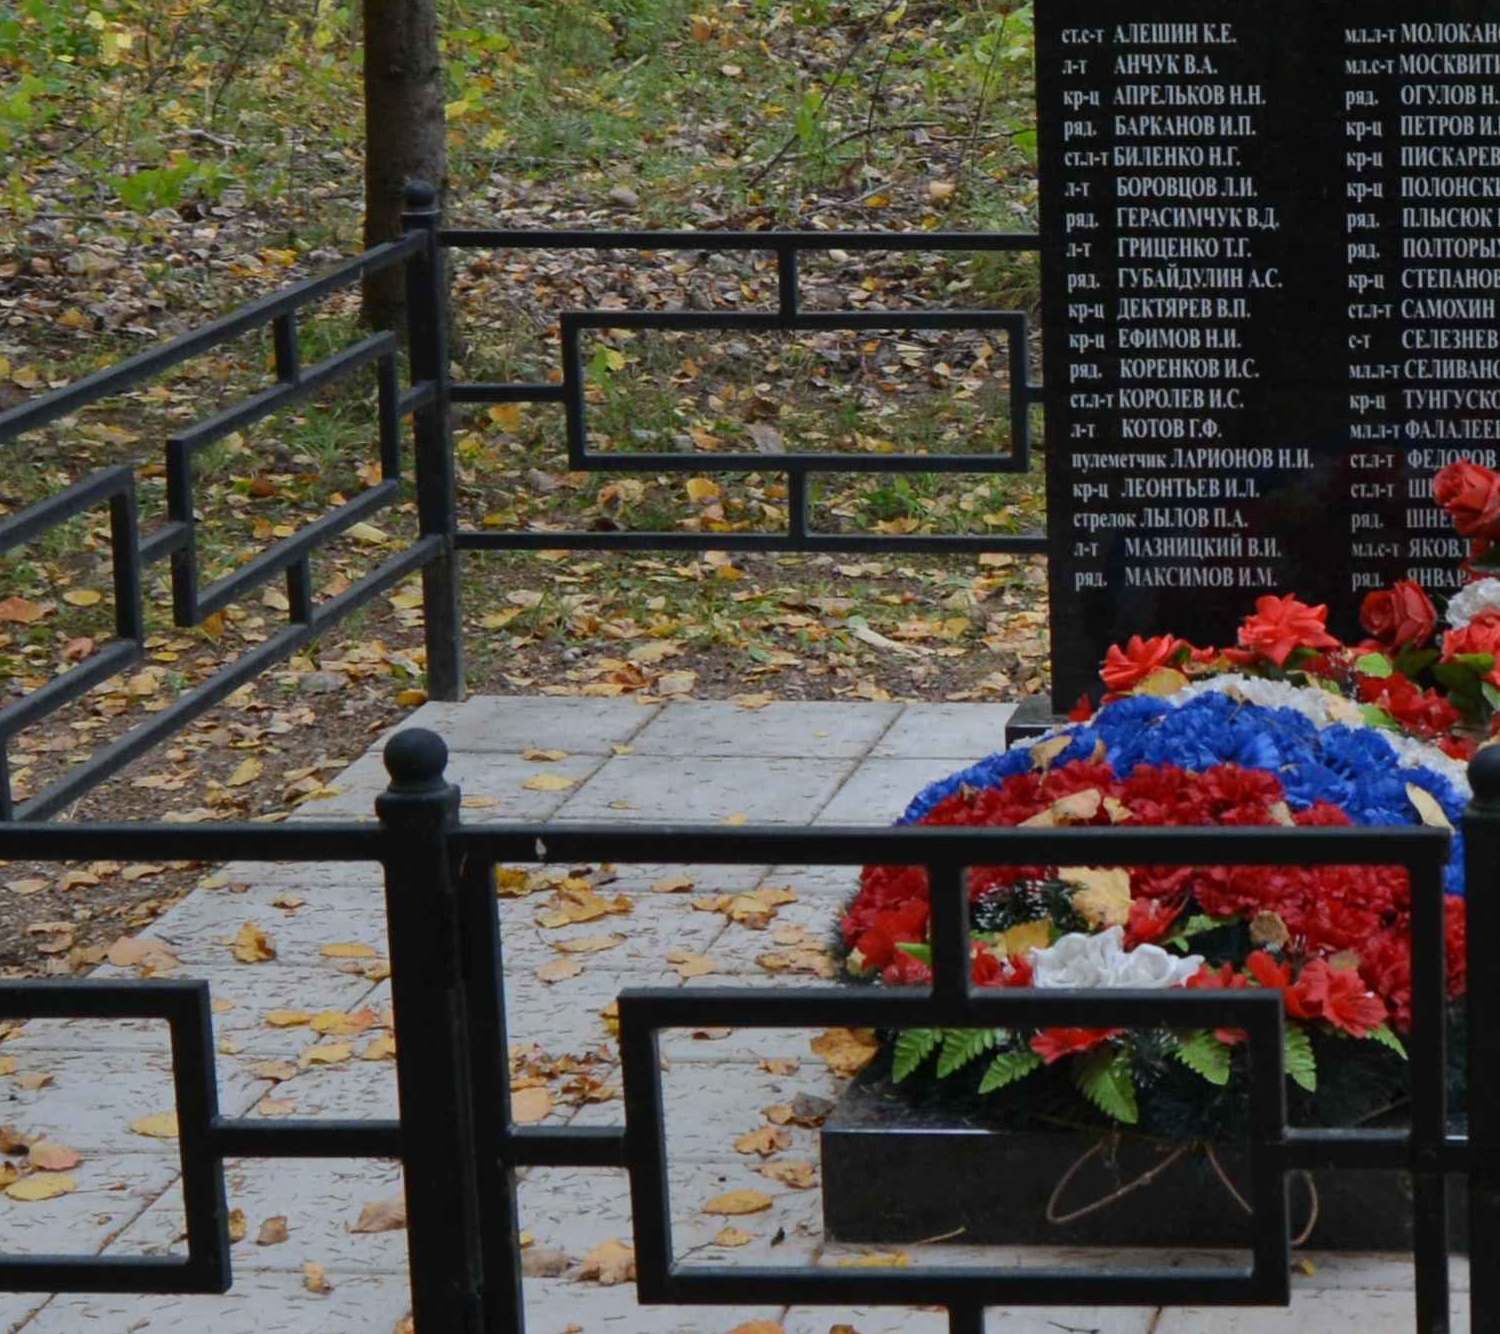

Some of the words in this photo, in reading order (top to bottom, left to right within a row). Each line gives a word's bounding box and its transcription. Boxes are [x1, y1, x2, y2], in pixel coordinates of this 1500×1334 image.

[1062, 28, 1104, 43] ст.с-т
[1114, 24, 1197, 43] АЛЕШИН
[1204, 24, 1236, 43] К.Е.
[1345, 28, 1396, 43] мл.л-т
[1062, 59, 1087, 74] л-т
[1115, 54, 1179, 74] АНЧУК
[1185, 54, 1217, 74] В.А.
[1346, 59, 1394, 74] мл.с-т
[1064, 90, 1100, 111] кр-ц
[1114, 85, 1225, 105] АПРЕЛЬКОВ
[1230, 85, 1266, 104] Н.Н.
[1346, 90, 1378, 110] ряд.
[1401, 85, 1476, 105] ОГУЛОВ
[1064, 120, 1097, 141] ряд.
[1116, 116, 1215, 135] БАРКАНОВ
[1220, 116, 1256, 135] И.П.
[1347, 121, 1382, 141] кр-ц
[1401, 116, 1474, 136] ПЕТРОВ
[1065, 151, 1108, 166] ст.л-т
[1114, 147, 1204, 166] БИЛЕНКО
[1209, 147, 1240, 166] Н.Г.
[1347, 151, 1382, 171] кр-ц
[1402, 147, 1500, 166] ПИСКАРЕВ
[1065, 181, 1090, 196] л-т
[1117, 177, 1217, 199] БОРОВЦОВ
[1221, 177, 1257, 197] Л.И.
[1347, 182, 1383, 203] кр-ц
[1066, 212, 1099, 232] ряд.
[1117, 207, 1242, 227] ГЕРАСИМЧУК
[1247, 208, 1279, 229] В.Д.
[1347, 213, 1380, 233] ряд.
[1403, 208, 1493, 227] ПЛЫСЮК
[1066, 242, 1091, 257] л-т
[1118, 238, 1219, 259] ГРИЦЕНКО
[1223, 238, 1251, 257] Т.Г.
[1348, 242, 1380, 264] ряд.
[1068, 273, 1100, 293] ряд.
[1118, 263, 1243, 290] ГУБАЙДУЛИН
[1249, 268, 1282, 288] А.С.
[1348, 274, 1384, 294] кр-ц
[1069, 303, 1104, 323] кр-ц
[1117, 298, 1212, 320] ДЕКТЯРЕВ
[1217, 298, 1250, 318] В.П.
[1348, 303, 1392, 318] ст.л-т
[1401, 299, 1495, 318] САМОХИН
[1070, 333, 1105, 353] кр-ц
[1119, 328, 1200, 348] ЕФИМОВ
[1206, 329, 1241, 348] Н.И.
[1349, 334, 1370, 349] с-т
[1402, 329, 1498, 349] СЕЛЕЗНЕВ
[1070, 363, 1102, 383] ряд.
[1121, 359, 1219, 378] КОРЕНКОВ
[1225, 358, 1259, 378] И.С.
[1349, 364, 1399, 379] мл.л-т
[1070, 393, 1114, 408] ст.л-т
[1120, 389, 1204, 408] КОРОЛЕВ
[1210, 389, 1244, 408] И.С.
[1350, 394, 1385, 414] кр-ц
[1071, 423, 1095, 438] л-т
[1122, 419, 1184, 438] КОТОВ
[1189, 419, 1222, 438] Г.Ф.
[1350, 424, 1400, 439] мл.л-т
[1072, 453, 1166, 473] пулеметчик
[1171, 449, 1273, 468] ЛАРИОНОВ
[1279, 449, 1314, 468] Н.И.
[1350, 453, 1394, 468] ст.л-т
[1073, 483, 1108, 502] кр-ц
[1121, 478, 1220, 497] ЛЕОНТЬЕВ
[1225, 478, 1260, 497] И.Л.
[1351, 483, 1394, 498] ст.л-т
[1074, 512, 1136, 533] стрелок
[1140, 508, 1209, 527] ЛЫЛОВ
[1214, 508, 1248, 527] П.А.
[1352, 513, 1383, 533] ряд.
[1074, 542, 1098, 557] л-т
[1125, 534, 1242, 559] МАЗНИЦКИЙ
[1248, 538, 1281, 557] В.И.
[1352, 542, 1399, 557] мл.с-т
[1409, 539, 1471, 557] ЯКОВЛ
[1075, 571, 1107, 591] ряд.
[1126, 567, 1234, 586] МАКСИМОВ
[1239, 567, 1277, 586] И.М.
[1352, 572, 1384, 592] ряд.
